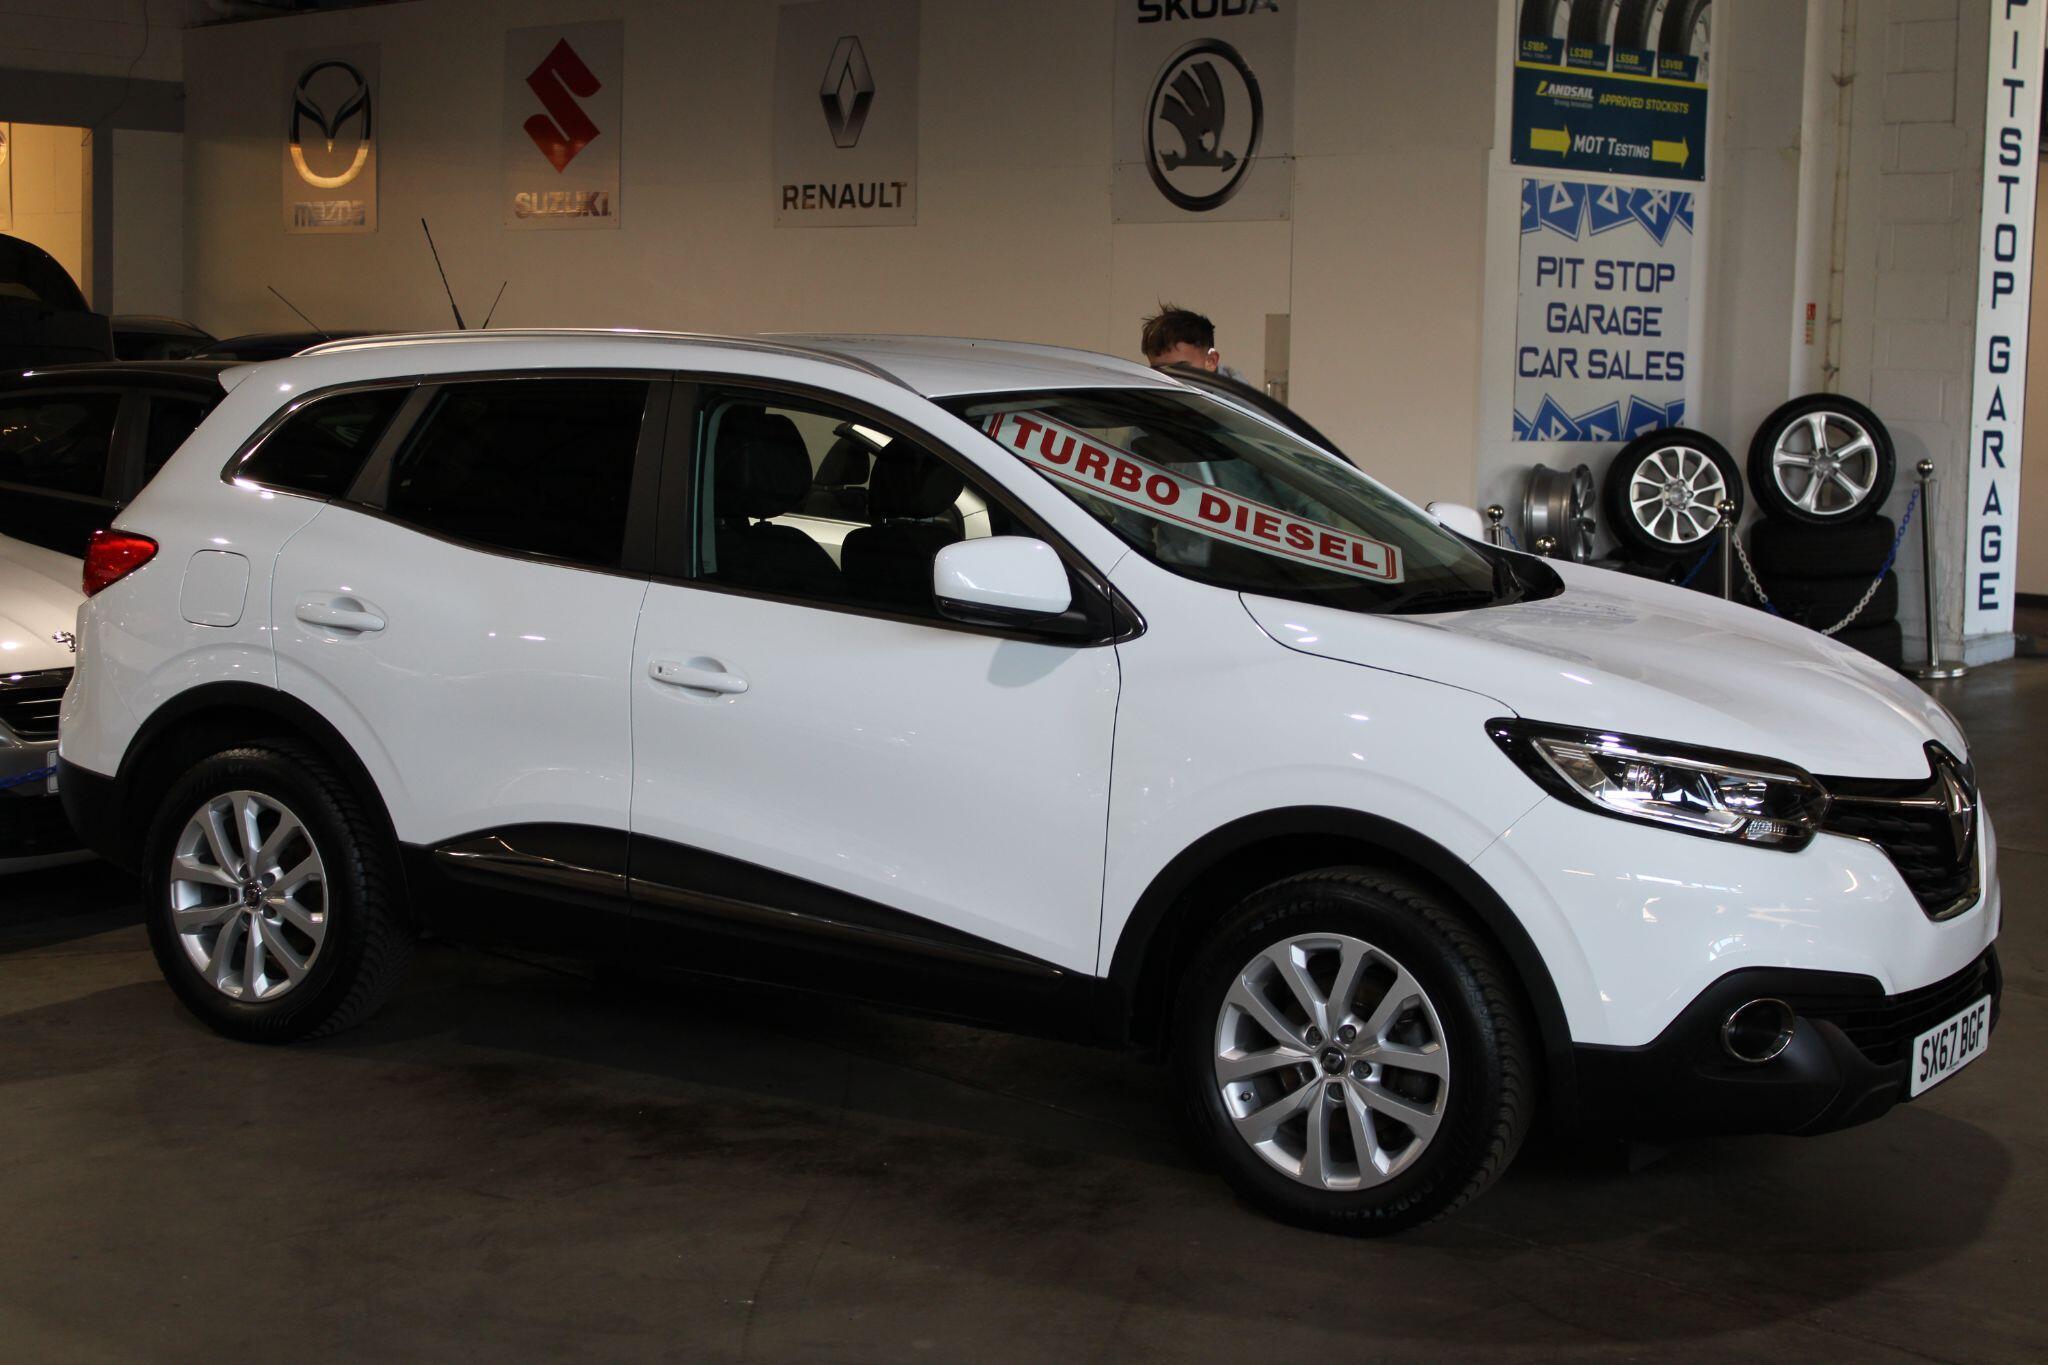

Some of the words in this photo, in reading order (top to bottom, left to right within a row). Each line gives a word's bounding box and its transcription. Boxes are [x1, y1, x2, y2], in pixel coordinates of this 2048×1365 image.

[1535, 80, 1594, 100] LANDSAIL
[1599, 93, 1644, 109] APPROVED
[1645, 98, 1689, 114] STOCKISTS
[1574, 134, 1604, 154] MOT
[514, 191, 608, 219] SUZUKI
[781, 181, 908, 211] RENAULT
[1991, 126, 2023, 310] STOP
[1536, 255, 1585, 289] PIT
[1594, 259, 1676, 293] STOP
[1546, 301, 1663, 337] GARAGE
[1518, 346, 1580, 379] CAR
[1587, 349, 1686, 382] SALES
[1978, 335, 2011, 611] GARAGE
[1012, 415, 1181, 506] TURBO
[1197, 491, 1379, 571] DIESEL
[1920, 1022, 1958, 1083] SX67
[1960, 1004, 1985, 1059] BGF
